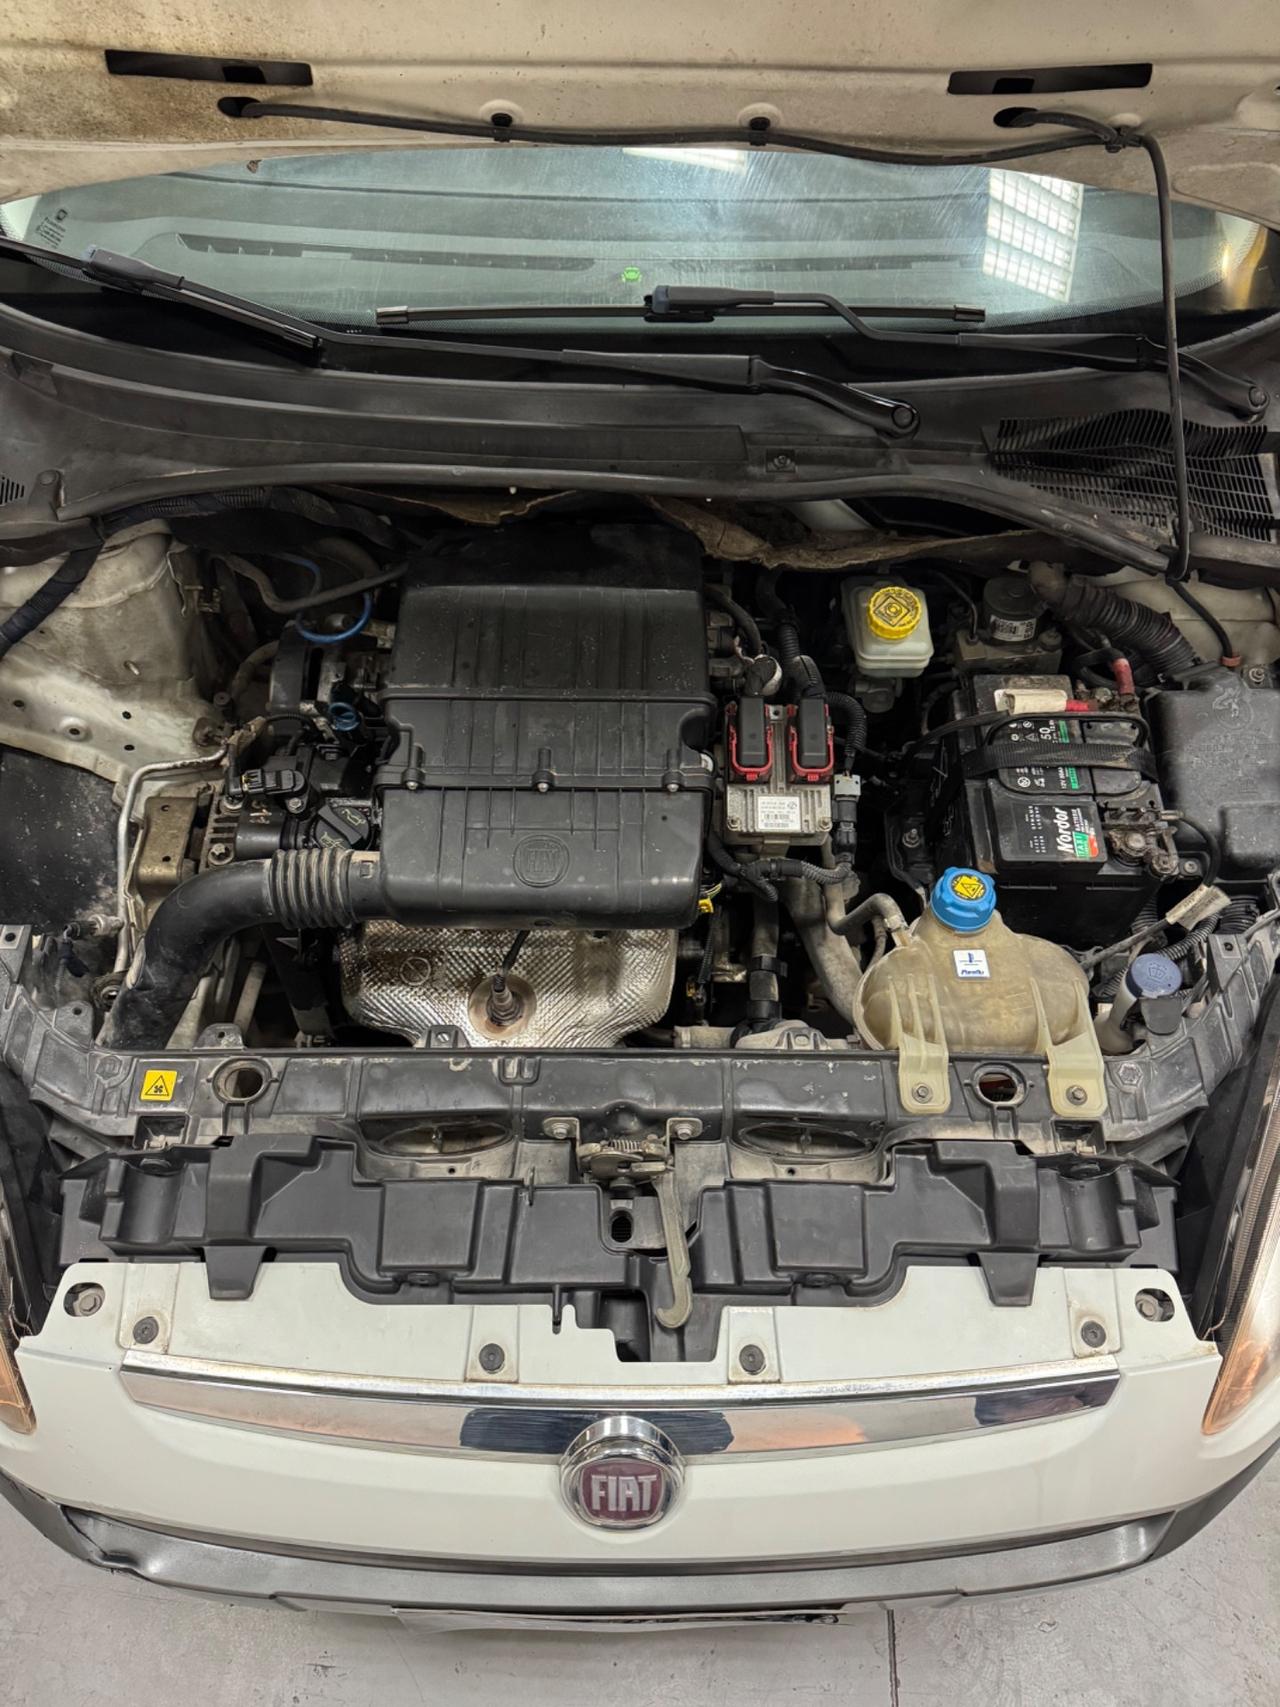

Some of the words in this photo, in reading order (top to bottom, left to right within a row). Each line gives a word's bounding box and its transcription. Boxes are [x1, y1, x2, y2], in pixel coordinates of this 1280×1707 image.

[1039, 727, 1052, 740] 50
[1053, 807, 1074, 853] Nordor
[1075, 836, 1084, 855] TAXI
[591, 1474, 657, 1512] FIAT
